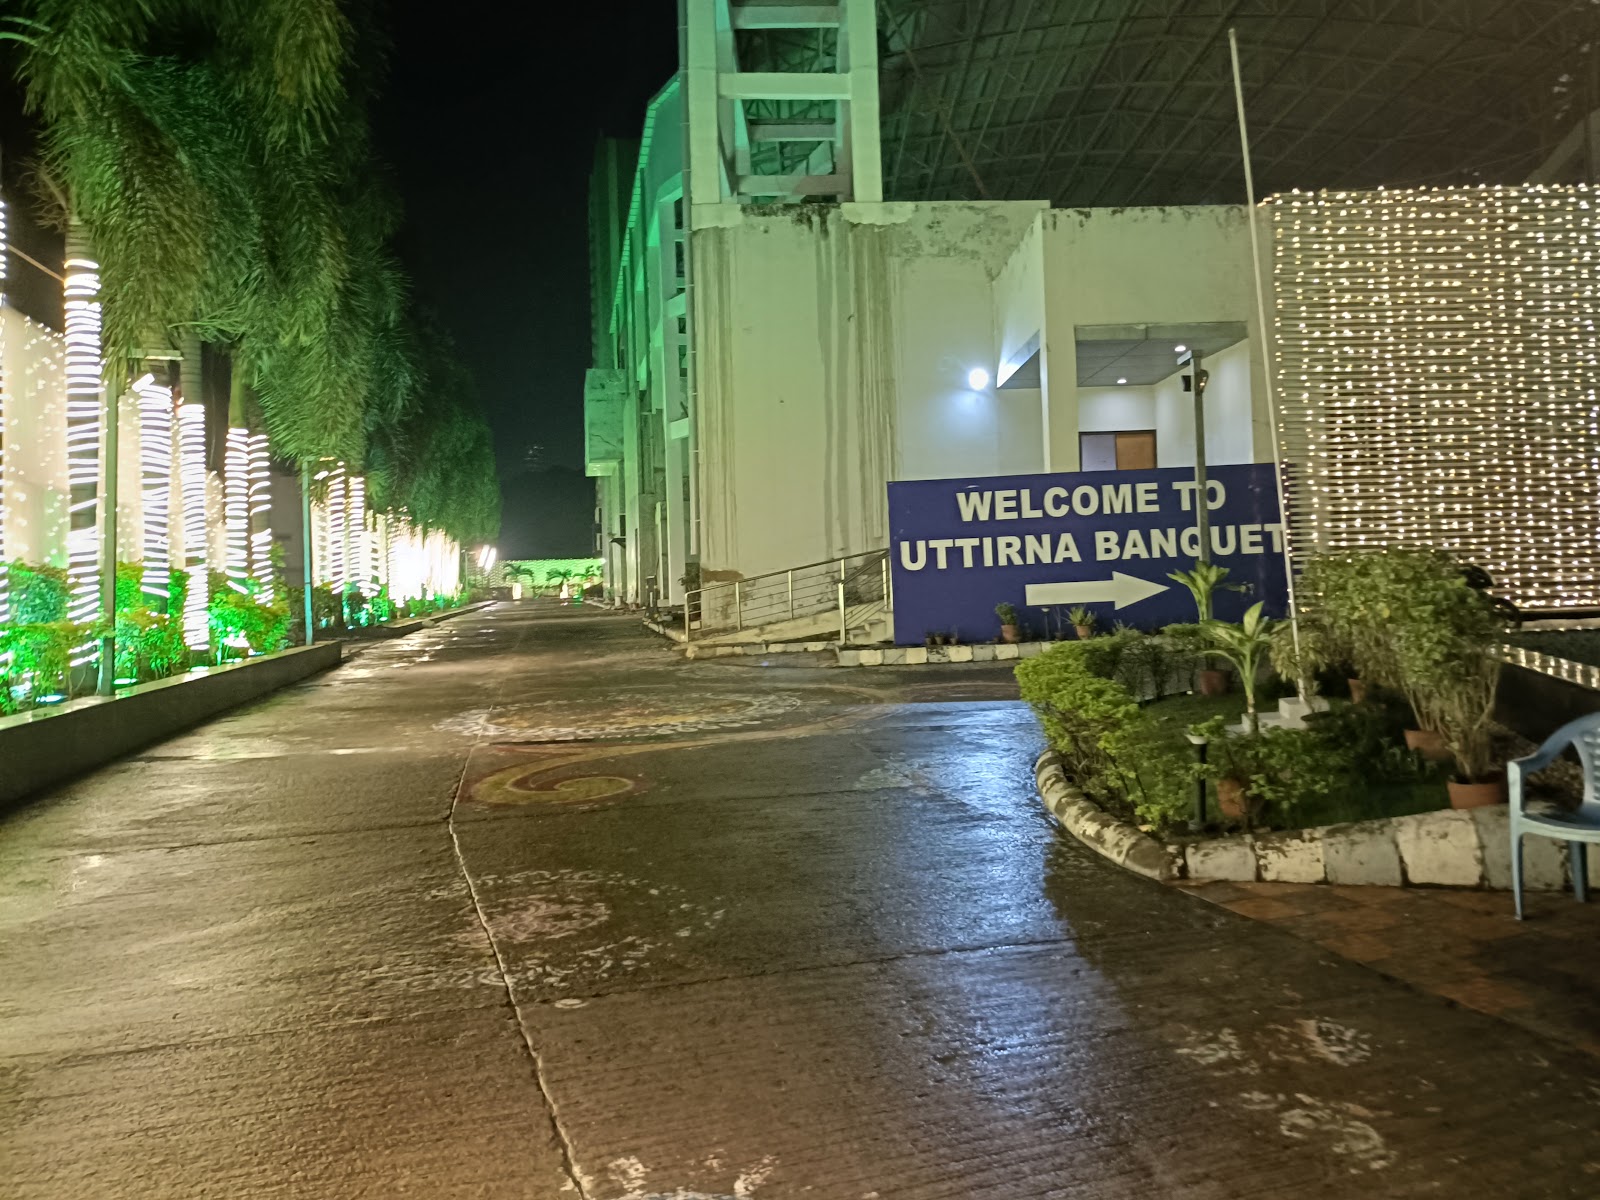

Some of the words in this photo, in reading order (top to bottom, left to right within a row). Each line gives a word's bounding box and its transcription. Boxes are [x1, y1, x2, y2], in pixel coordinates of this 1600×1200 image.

[956, 482, 1160, 522] WELCOME
[1172, 479, 1226, 512] TO
[900, 532, 1081, 571] UTTIRNA
[1094, 523, 1283, 561] BANQUET
